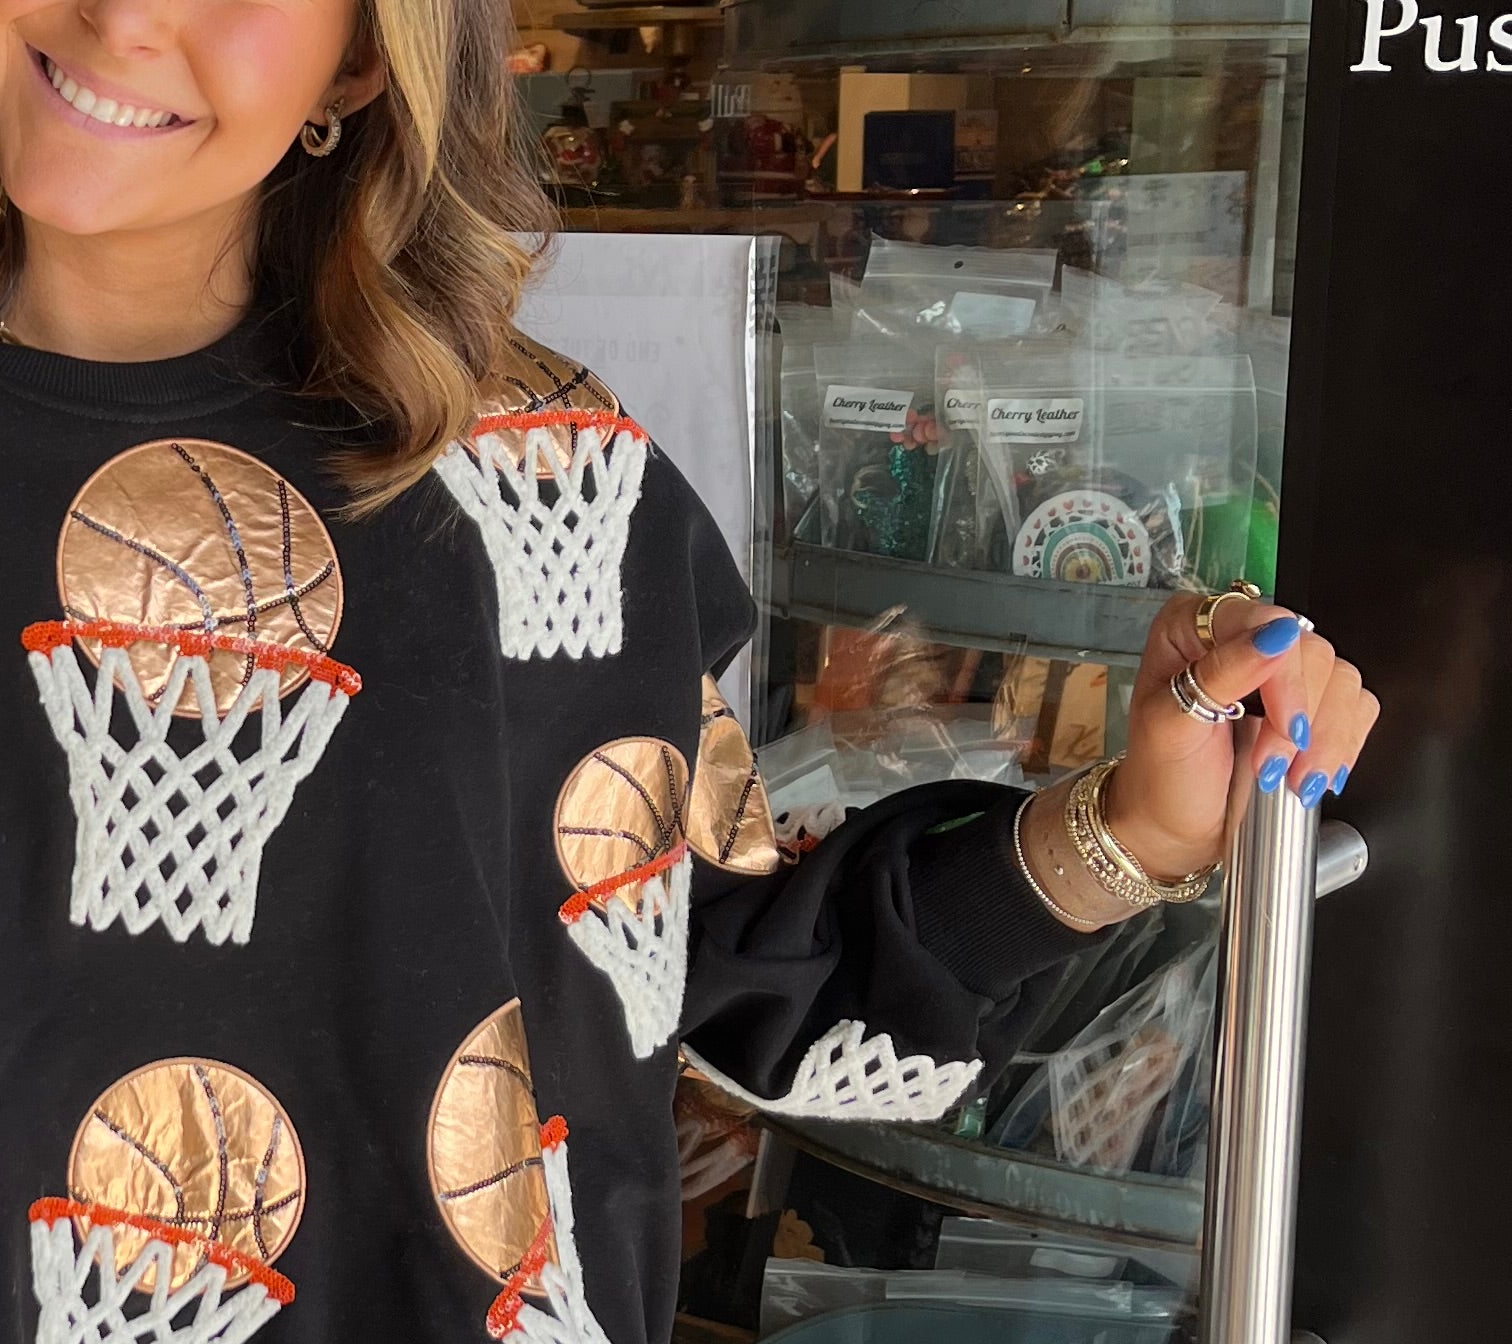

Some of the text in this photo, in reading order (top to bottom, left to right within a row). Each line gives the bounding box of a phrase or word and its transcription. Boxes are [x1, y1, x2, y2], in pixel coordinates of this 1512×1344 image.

[833, 397, 906, 413] Cherry Leather
[991, 408, 1033, 423] Cherry
[1036, 408, 1080, 424] Leather
